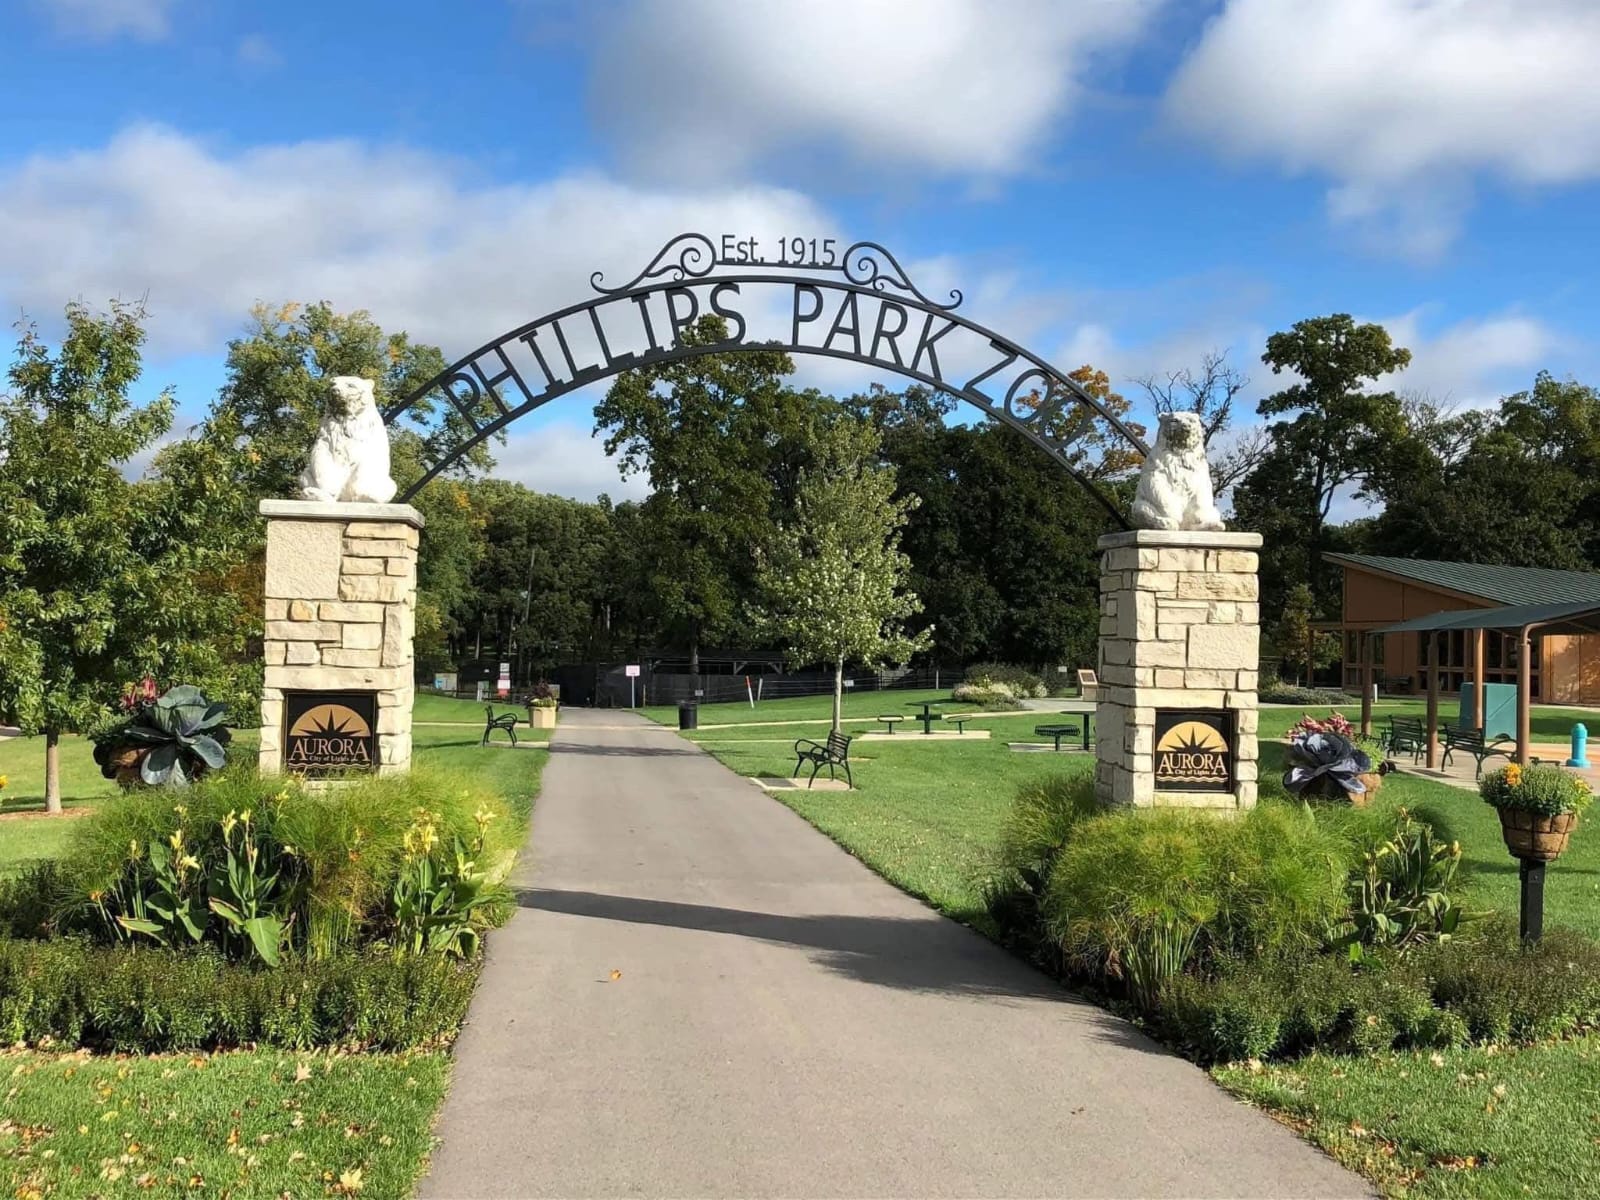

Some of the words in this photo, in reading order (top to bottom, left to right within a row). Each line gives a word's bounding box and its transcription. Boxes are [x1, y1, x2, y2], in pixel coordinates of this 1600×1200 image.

[721, 234, 764, 264] Est.
[778, 237, 836, 266] 1915
[438, 281, 746, 433] PHILLIPS
[791, 283, 960, 382] PARK
[962, 338, 1092, 450] ZOO
[288, 738, 371, 761] AURORA
[1156, 753, 1228, 775] AURORA
